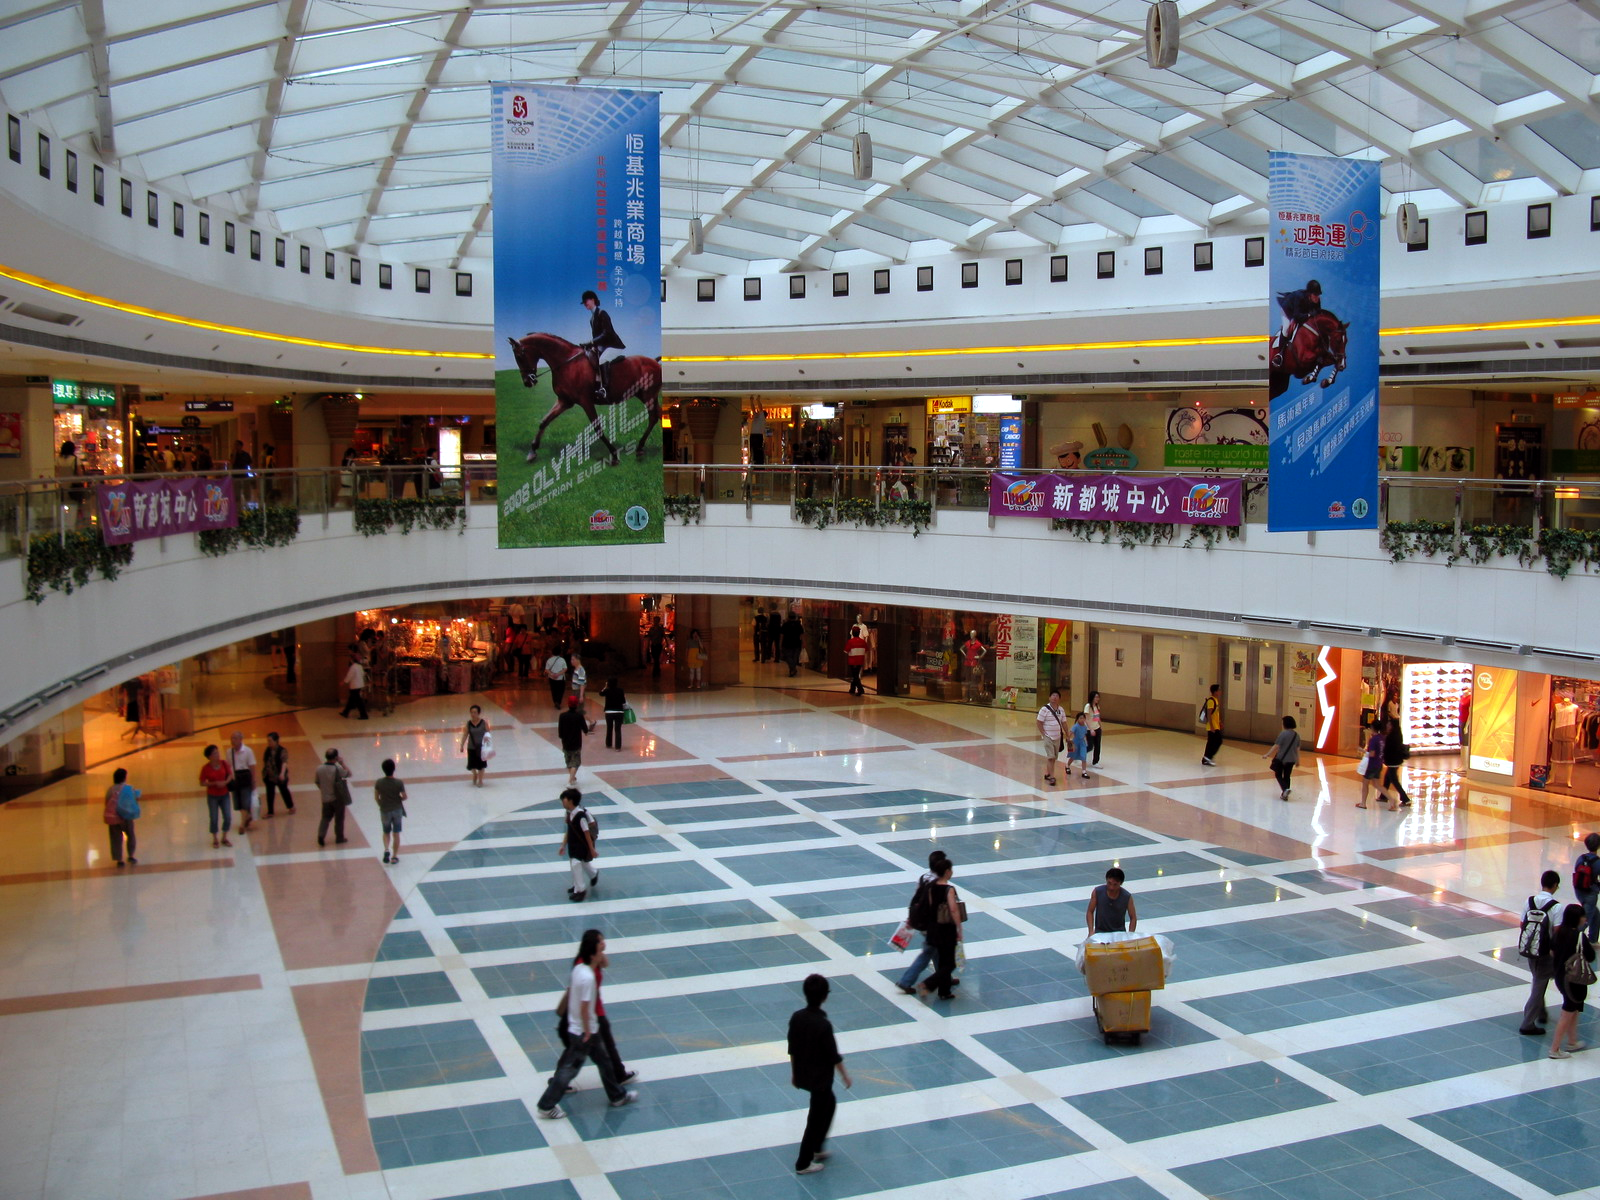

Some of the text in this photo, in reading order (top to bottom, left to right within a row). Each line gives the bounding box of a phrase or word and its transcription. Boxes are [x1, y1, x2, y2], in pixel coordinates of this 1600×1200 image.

[625, 132, 645, 265] 恒基兆業商場
[1293, 223, 1347, 248] 迎奧運
[613, 219, 624, 307] 跨越動感 全力支持
[939, 399, 954, 408] Kodak
[504, 373, 654, 516] 2008 OLYMPIC
[577, 439, 637, 484] EVENTS
[1203, 448, 1220, 459] the
[1222, 448, 1250, 459] world
[132, 489, 198, 529] 新都城中心
[1052, 482, 1170, 514] 新都城中心
